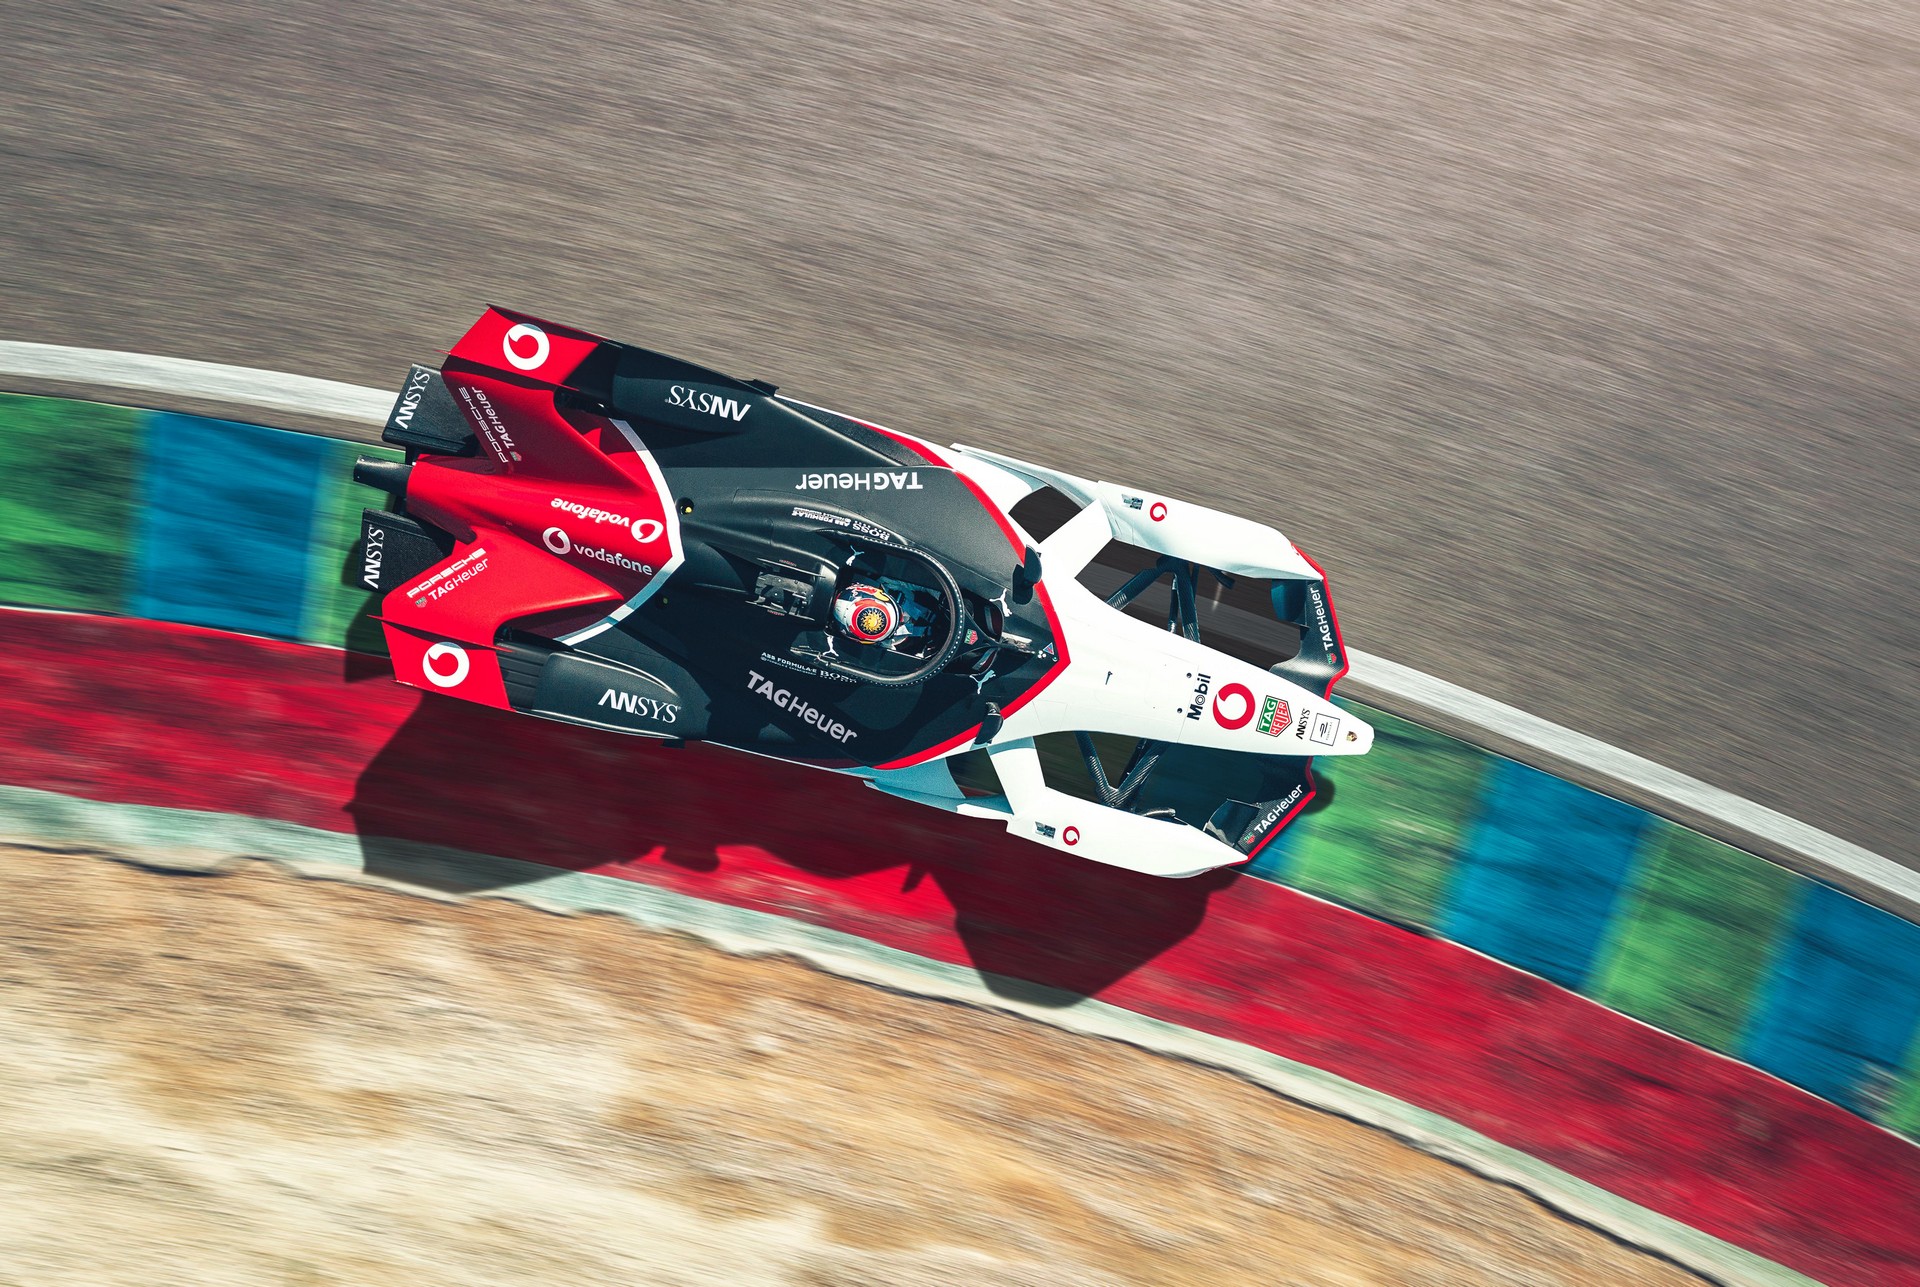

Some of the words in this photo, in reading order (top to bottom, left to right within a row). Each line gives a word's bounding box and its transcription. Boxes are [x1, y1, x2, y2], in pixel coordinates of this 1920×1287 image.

[395, 366, 431, 430] ANSYS
[668, 385, 751, 422] ANSYS
[458, 387, 508, 463] PORSCHE
[551, 498, 629, 527] vodafone
[363, 526, 385, 589] ANSYS
[407, 548, 487, 598] PORSCHE
[574, 543, 653, 576] vodafone
[598, 689, 679, 724] ANSYS
[1187, 673, 1211, 721] Mobil
[1260, 700, 1276, 729] TAG
[1271, 702, 1289, 734] HEUER
[1296, 708, 1311, 740] ANSYS
